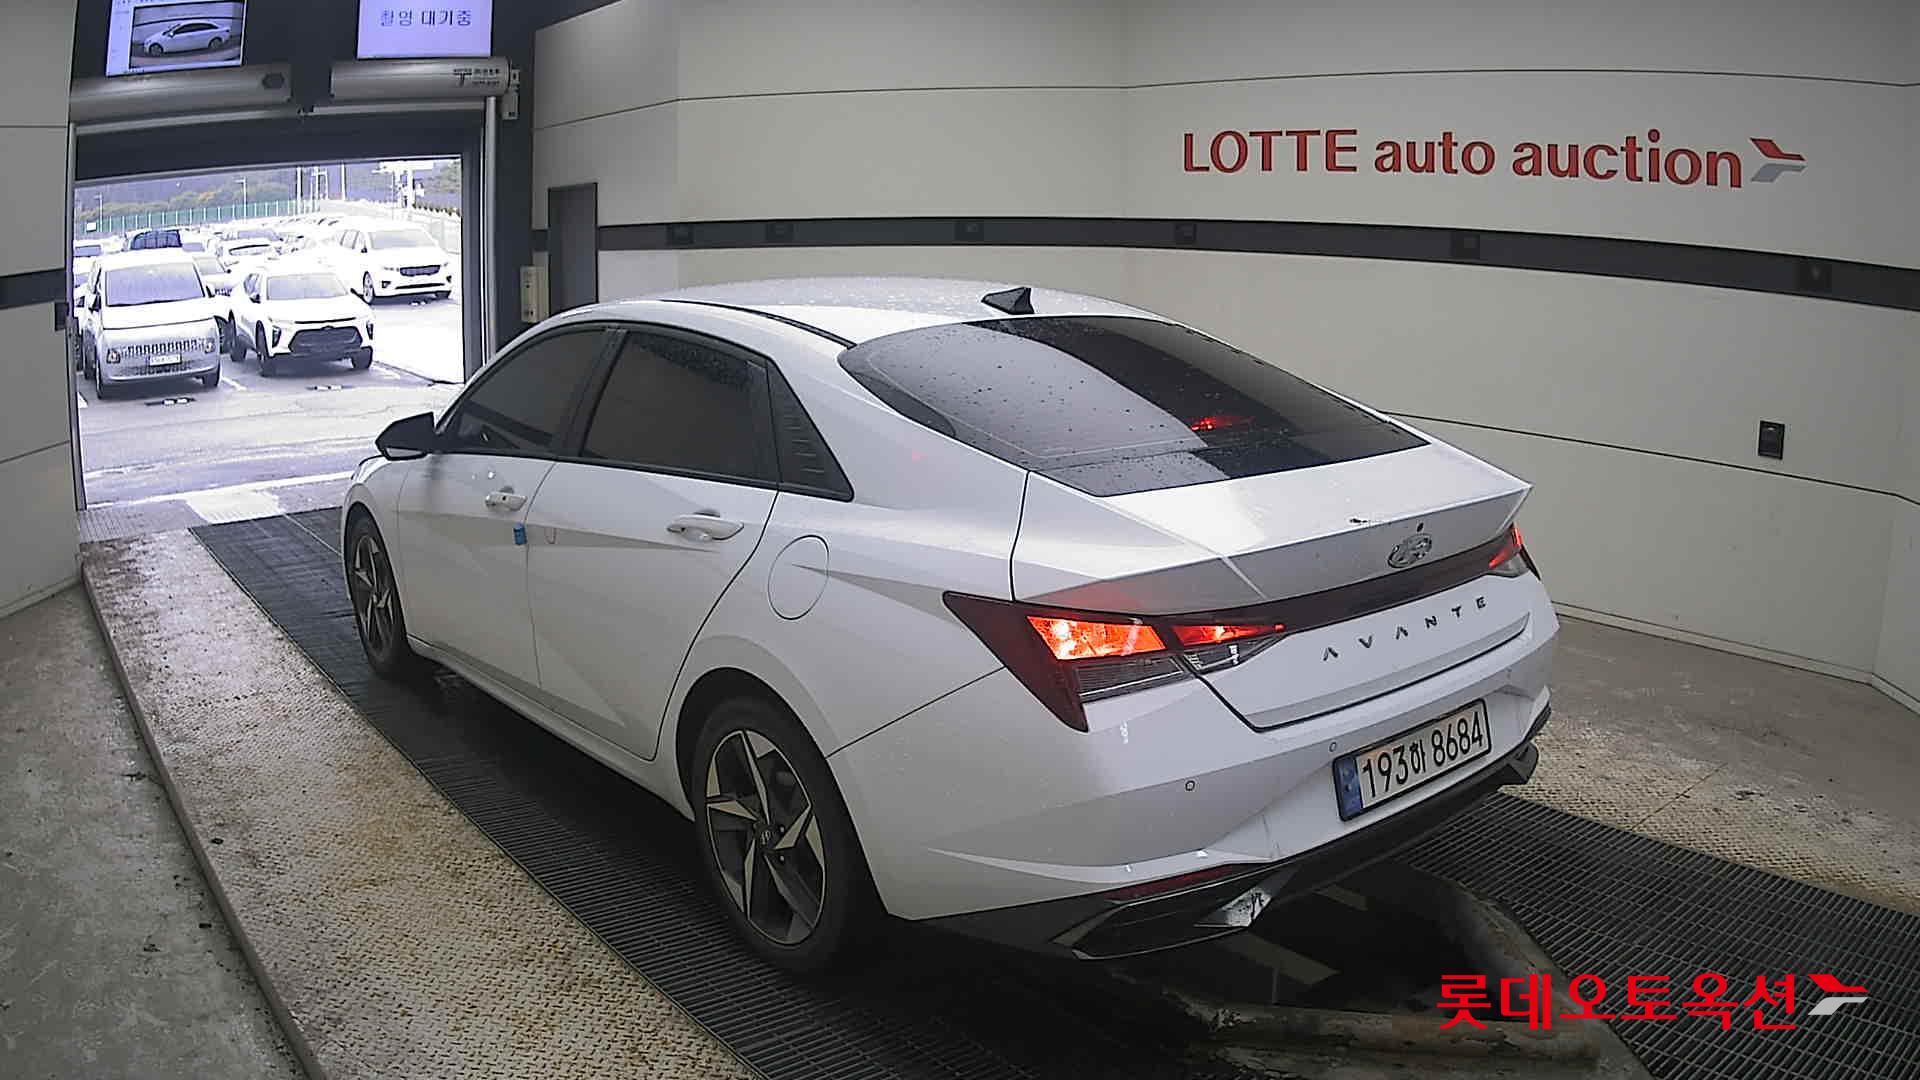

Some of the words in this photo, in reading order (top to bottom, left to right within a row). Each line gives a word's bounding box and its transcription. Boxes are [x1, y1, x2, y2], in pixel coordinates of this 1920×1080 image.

[421, 9, 472, 26] 대기중
[1183, 128, 1358, 174] LOTTE
[1374, 131, 1496, 175] auto
[1511, 128, 1743, 189] auction
[1322, 596, 1487, 662] AVANTE
[1361, 739, 1427, 798] 193하
[1431, 711, 1484, 768] 8684
